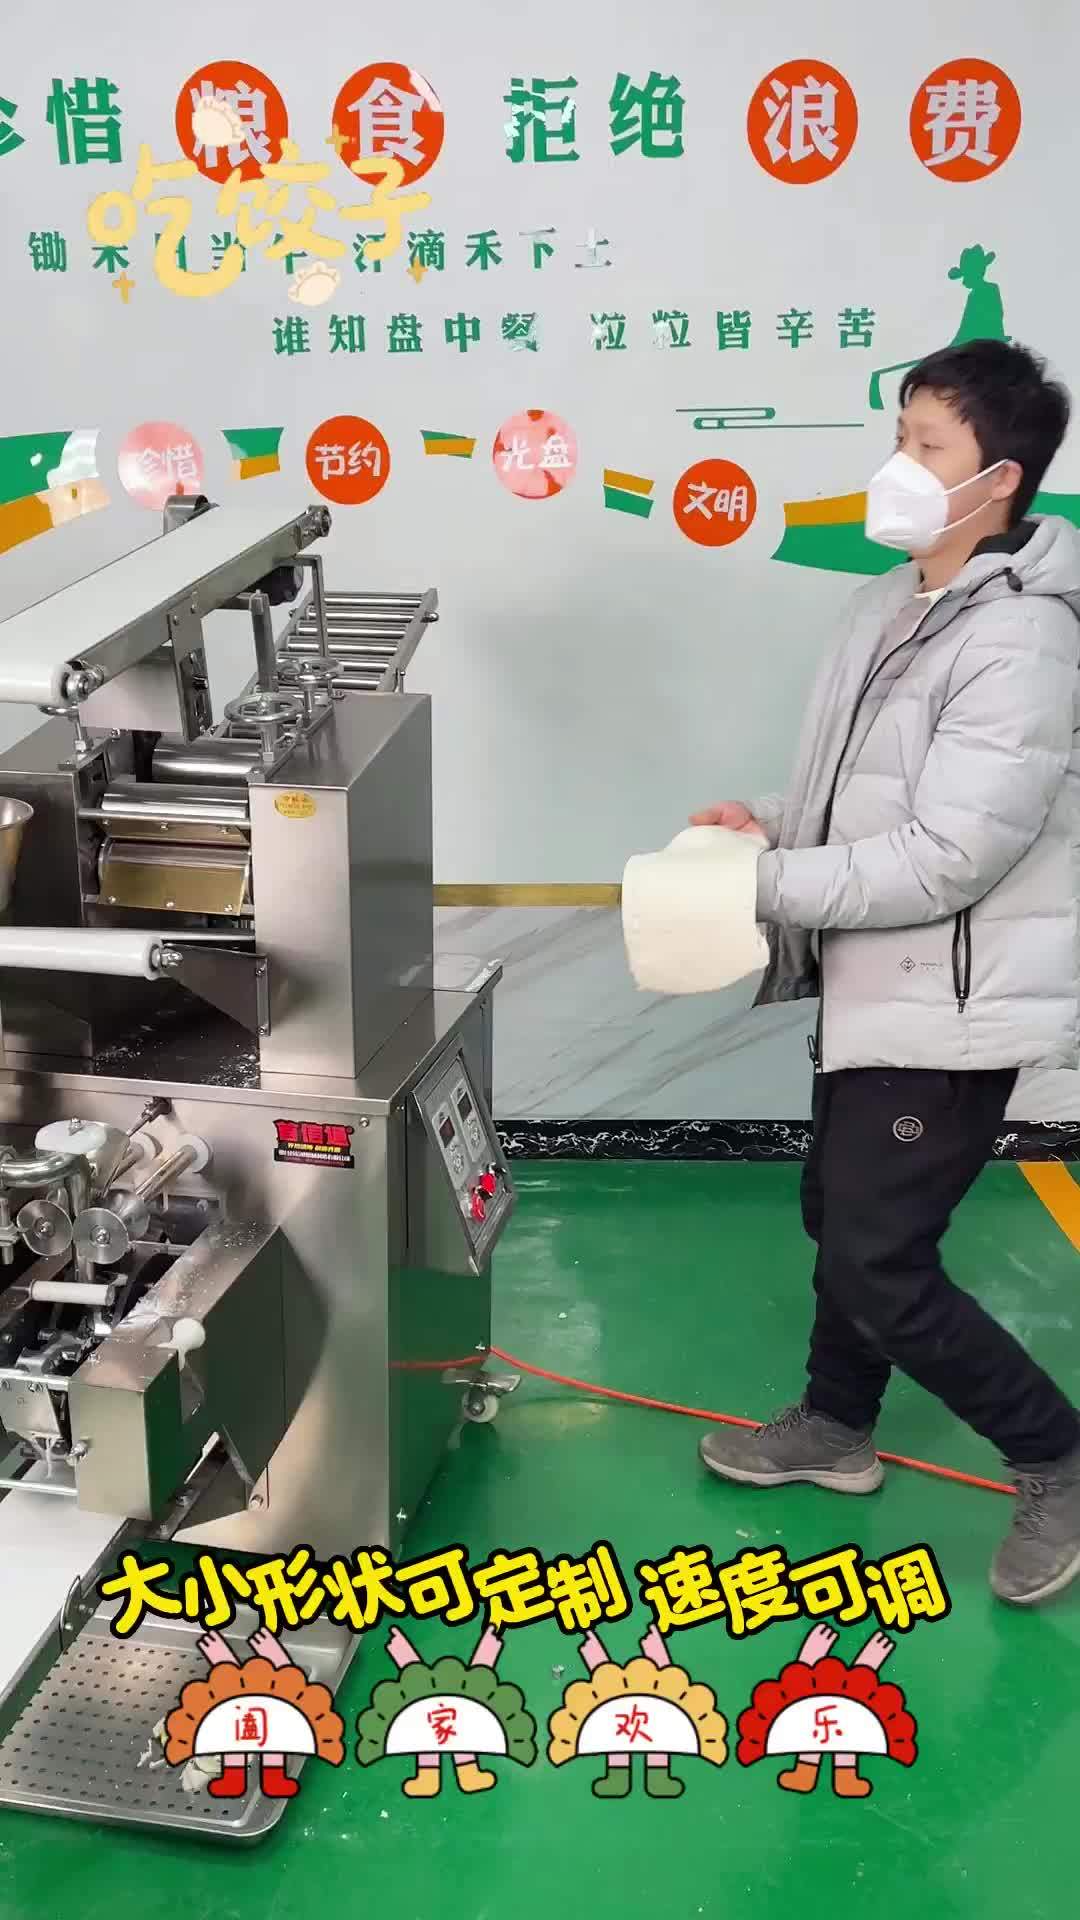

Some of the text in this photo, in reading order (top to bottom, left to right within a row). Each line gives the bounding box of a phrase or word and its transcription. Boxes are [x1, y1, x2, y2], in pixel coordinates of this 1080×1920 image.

[502, 71, 687, 163] 拒绝
[761, 75, 1002, 168] 浪费
[589, 307, 877, 351] 粒粒皆辛苦
[314, 440, 382, 481] 节约
[499, 433, 573, 472] 光盘
[682, 481, 748, 523] 文明
